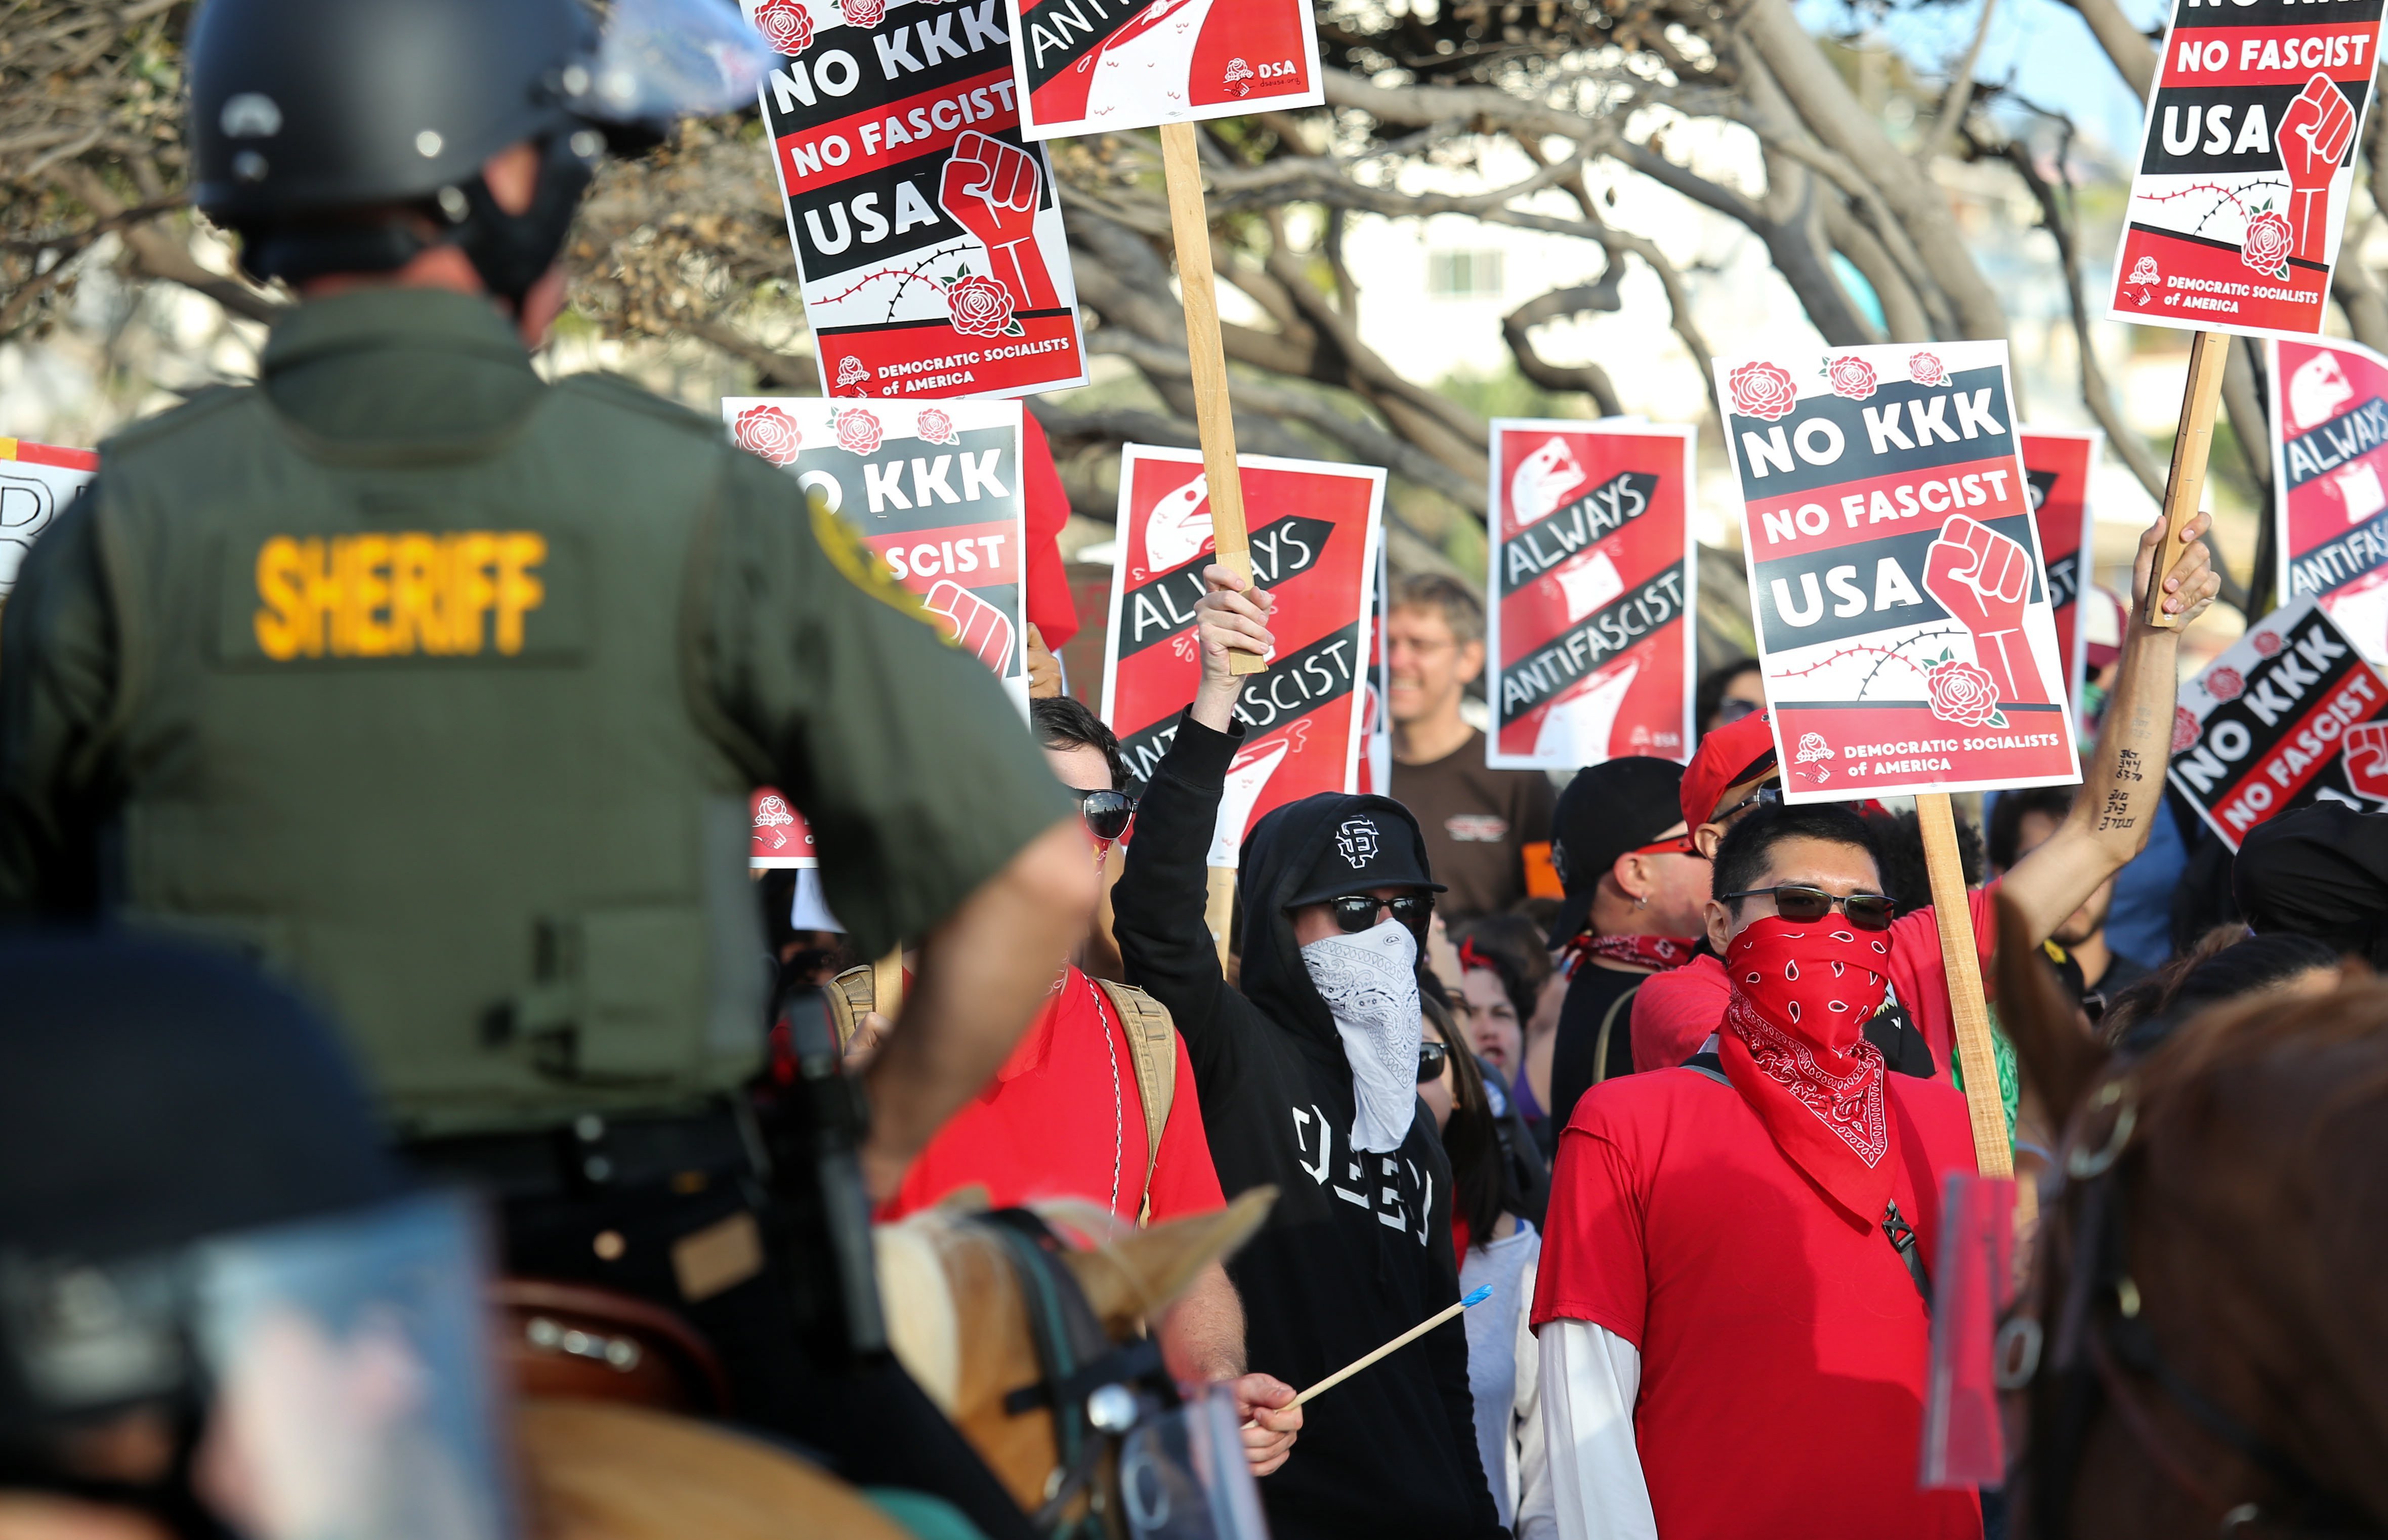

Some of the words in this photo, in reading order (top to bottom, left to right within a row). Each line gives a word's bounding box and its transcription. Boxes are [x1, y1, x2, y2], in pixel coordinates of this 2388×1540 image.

[769, 49, 860, 114] NO
[873, 0, 1010, 80] KKK
[1258, 60, 1296, 78] DSA
[1260, 77, 1301, 88] dsausa.org
[2177, 40, 2229, 72] NO
[2240, 34, 2370, 70] FASCIST
[790, 135, 850, 177] NO
[859, 78, 1015, 156] FASCIST
[2162, 104, 2271, 156] USA
[804, 180, 940, 255] USA
[2164, 295, 2180, 306] of
[2183, 297, 2239, 313] AMERICA
[2167, 275, 2248, 298] DEMOCRATIC
[2252, 286, 2318, 304] SOCIALISTS
[878, 354, 980, 379] DEMOCRATIC
[985, 338, 1069, 362] SOCIALISTS
[883, 382, 899, 396] of
[906, 371, 974, 393] AMERICA
[1741, 418, 1846, 478] NO
[1862, 388, 2007, 455] KKK
[797, 470, 843, 515] O
[863, 448, 1011, 513] KKK
[1762, 503, 1829, 545] NO
[1842, 469, 2008, 528] FASCIST
[1507, 474, 1645, 585] ALWAYS
[254, 530, 547, 661] SHERIFF
[1135, 521, 1311, 642] ALYS
[1771, 557, 1923, 628] USA
[1504, 570, 1684, 715] ANTIFASCIST
[2177, 719, 2251, 794] NO
[2243, 624, 2348, 727] KKK
[1844, 737, 1958, 759] DEMOCRATIC
[1964, 734, 2059, 750] SOCIALISTS
[1848, 763, 1868, 777] of
[1874, 758, 1952, 775] AMERICA
[2223, 782, 2273, 831] NO
[2267, 675, 2375, 788] FASCIST
